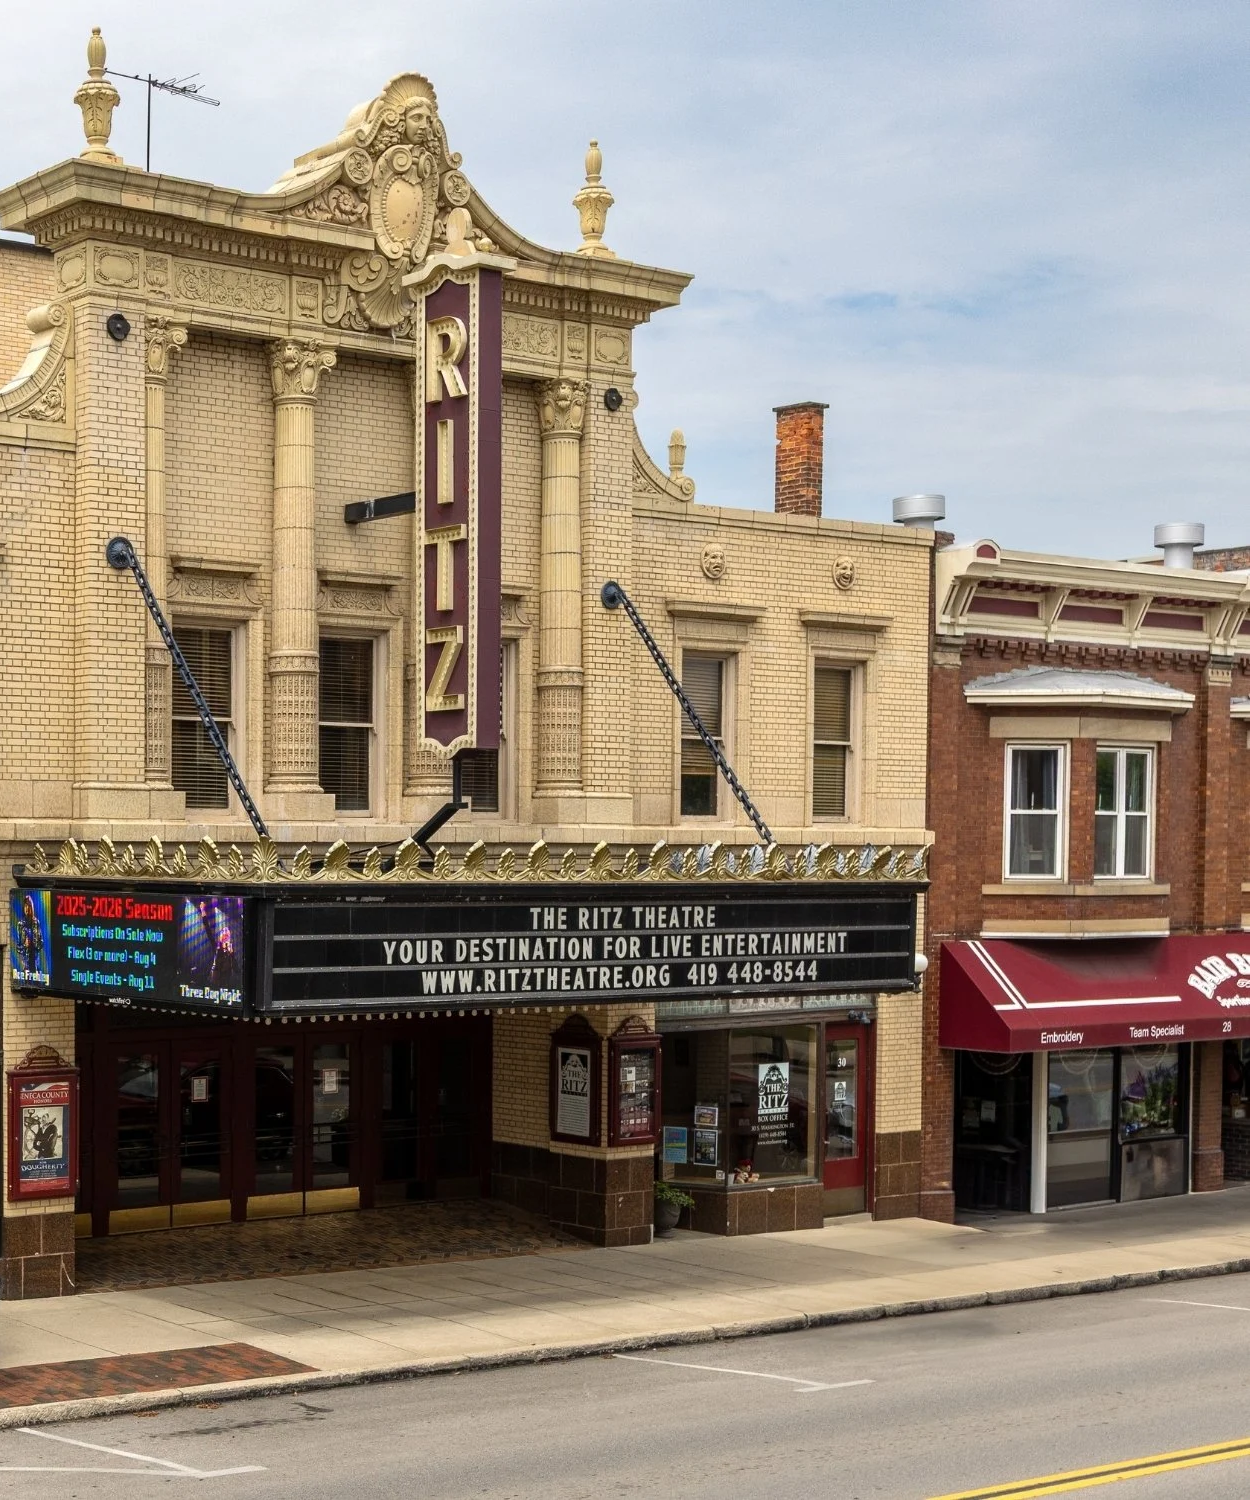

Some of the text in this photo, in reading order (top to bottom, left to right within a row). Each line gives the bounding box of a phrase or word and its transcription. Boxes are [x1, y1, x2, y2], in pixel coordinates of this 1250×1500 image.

[426, 315, 469, 713] RITZ
[56, 895, 173, 921] 2025-2026 Season
[529, 906, 716, 930] THE RITZ THEATRE
[62, 923, 164, 943] Subscriptions On Sale Now
[383, 932, 847, 965] YOUR DESTINATION FOR LIVE ENTERTAINMENT
[67, 946, 85, 959] Flex
[86, 946, 93, 960] (3
[93, 950, 104, 961] or
[104, 949, 128, 963] more)
[134, 951, 149, 968] Aug
[150, 952, 156, 966] 4
[12, 968, 25, 980] Ace
[71, 969, 94, 986] Single
[94, 971, 122, 986] Events
[128, 974, 144, 991] Aug
[144, 975, 155, 989] 11
[421, 960, 818, 994] WWW.RITZTHEATRE.ORG 419 448-8544
[179, 984, 242, 1006] Three Dog Night
[1129, 1024, 1185, 1039] Team Specialist
[1222, 1021, 1232, 1033] 28
[1040, 1031, 1085, 1044] Embroidery
[837, 1057, 847, 1068] 30
[567, 1070, 582, 1079] THE
[561, 1078, 588, 1093] RITZ
[765, 1083, 782, 1093] THE
[20, 1090, 69, 1100] ENECA COUNTY
[758, 1093, 790, 1110] RITZ
[757, 1113, 789, 1123] BOX OFFICE
[20, 1163, 66, 1172] DOUGHERTY
